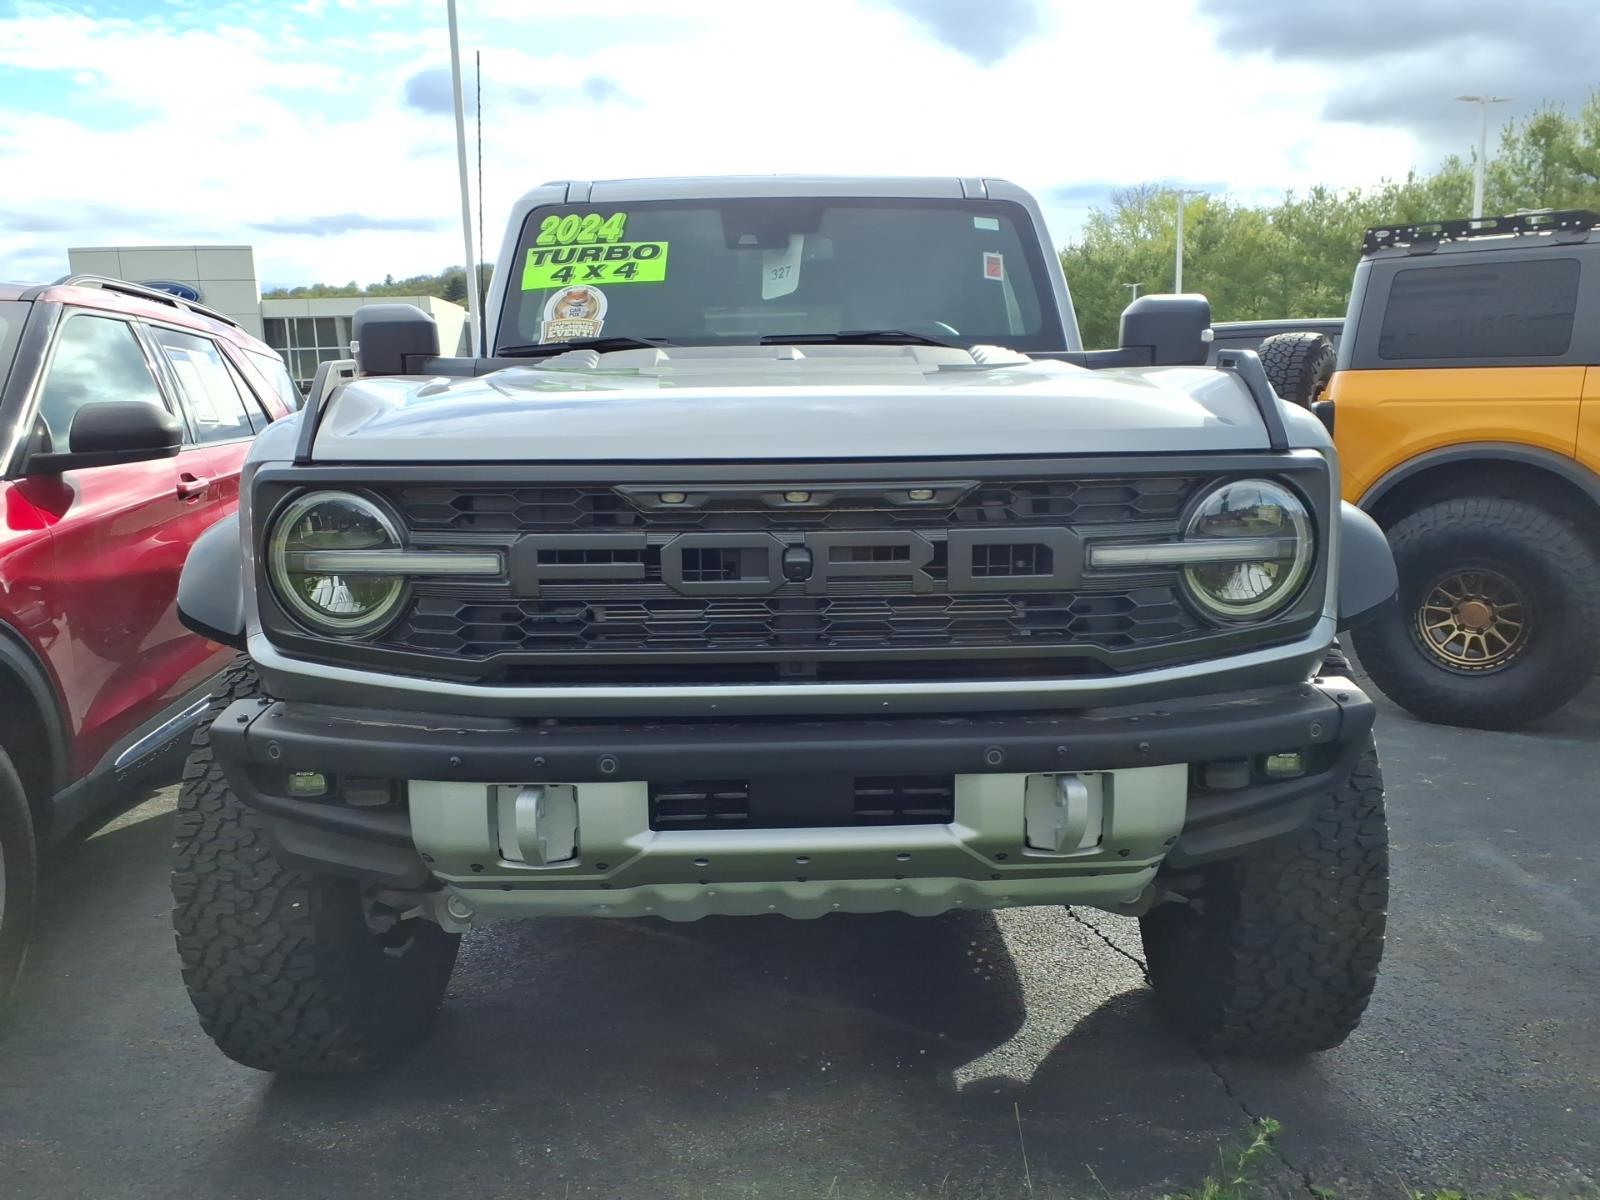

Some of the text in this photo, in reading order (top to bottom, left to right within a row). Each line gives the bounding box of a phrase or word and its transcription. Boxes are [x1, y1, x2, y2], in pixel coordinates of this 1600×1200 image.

[536, 212, 627, 245] 2024
[532, 244, 662, 267] TURBO
[771, 265, 792, 281] 327
[546, 329, 594, 338] EVENT!
[511, 528, 1082, 598] FORD
